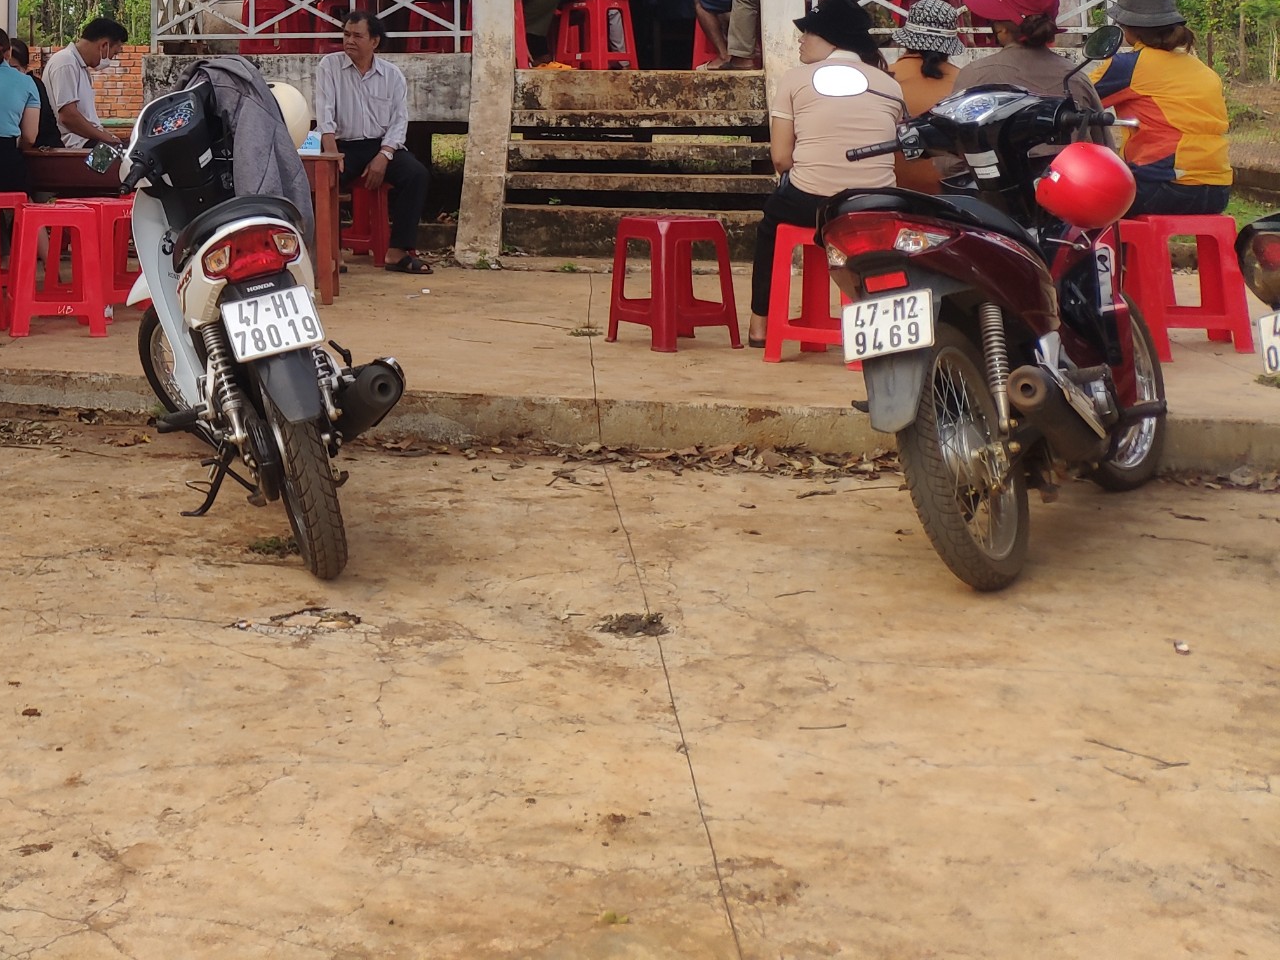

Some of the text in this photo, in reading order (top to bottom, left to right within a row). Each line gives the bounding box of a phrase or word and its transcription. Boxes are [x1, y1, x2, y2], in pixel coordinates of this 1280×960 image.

[246, 281, 275, 293] HONDA
[237, 290, 299, 327] 47-H1
[854, 295, 919, 329] 47-M2
[233, 315, 319, 357] 780.19
[854, 321, 920, 356] 9469
